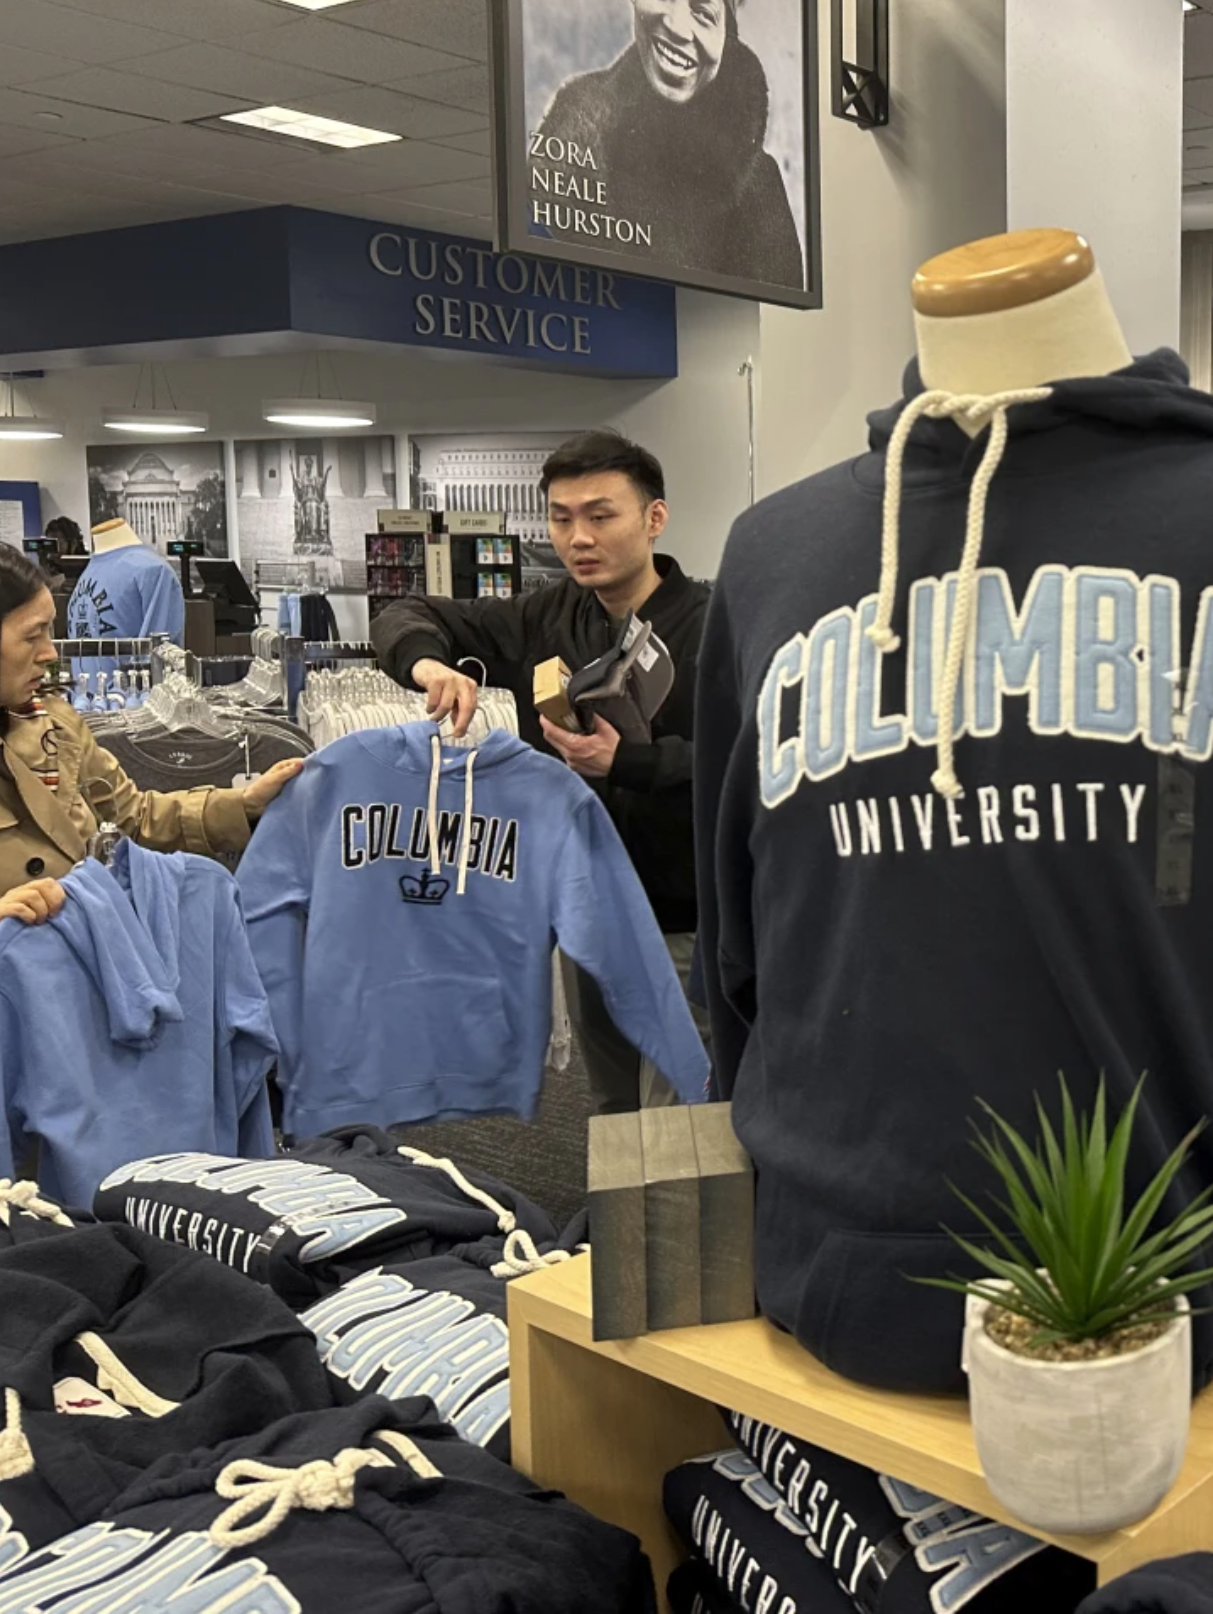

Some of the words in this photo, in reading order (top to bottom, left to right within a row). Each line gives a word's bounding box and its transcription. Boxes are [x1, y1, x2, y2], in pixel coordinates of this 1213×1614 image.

[530, 132, 597, 170] ZORA
[531, 165, 607, 205] NEALE
[533, 200, 651, 246] HURSTON
[369, 232, 623, 310] CUSTOMER
[414, 293, 592, 354] SERVICE
[341, 802, 519, 883] COLUMBIA
[829, 781, 1147, 857] UNIVERSITY
[125, 1196, 261, 1274] UNIVERSITY
